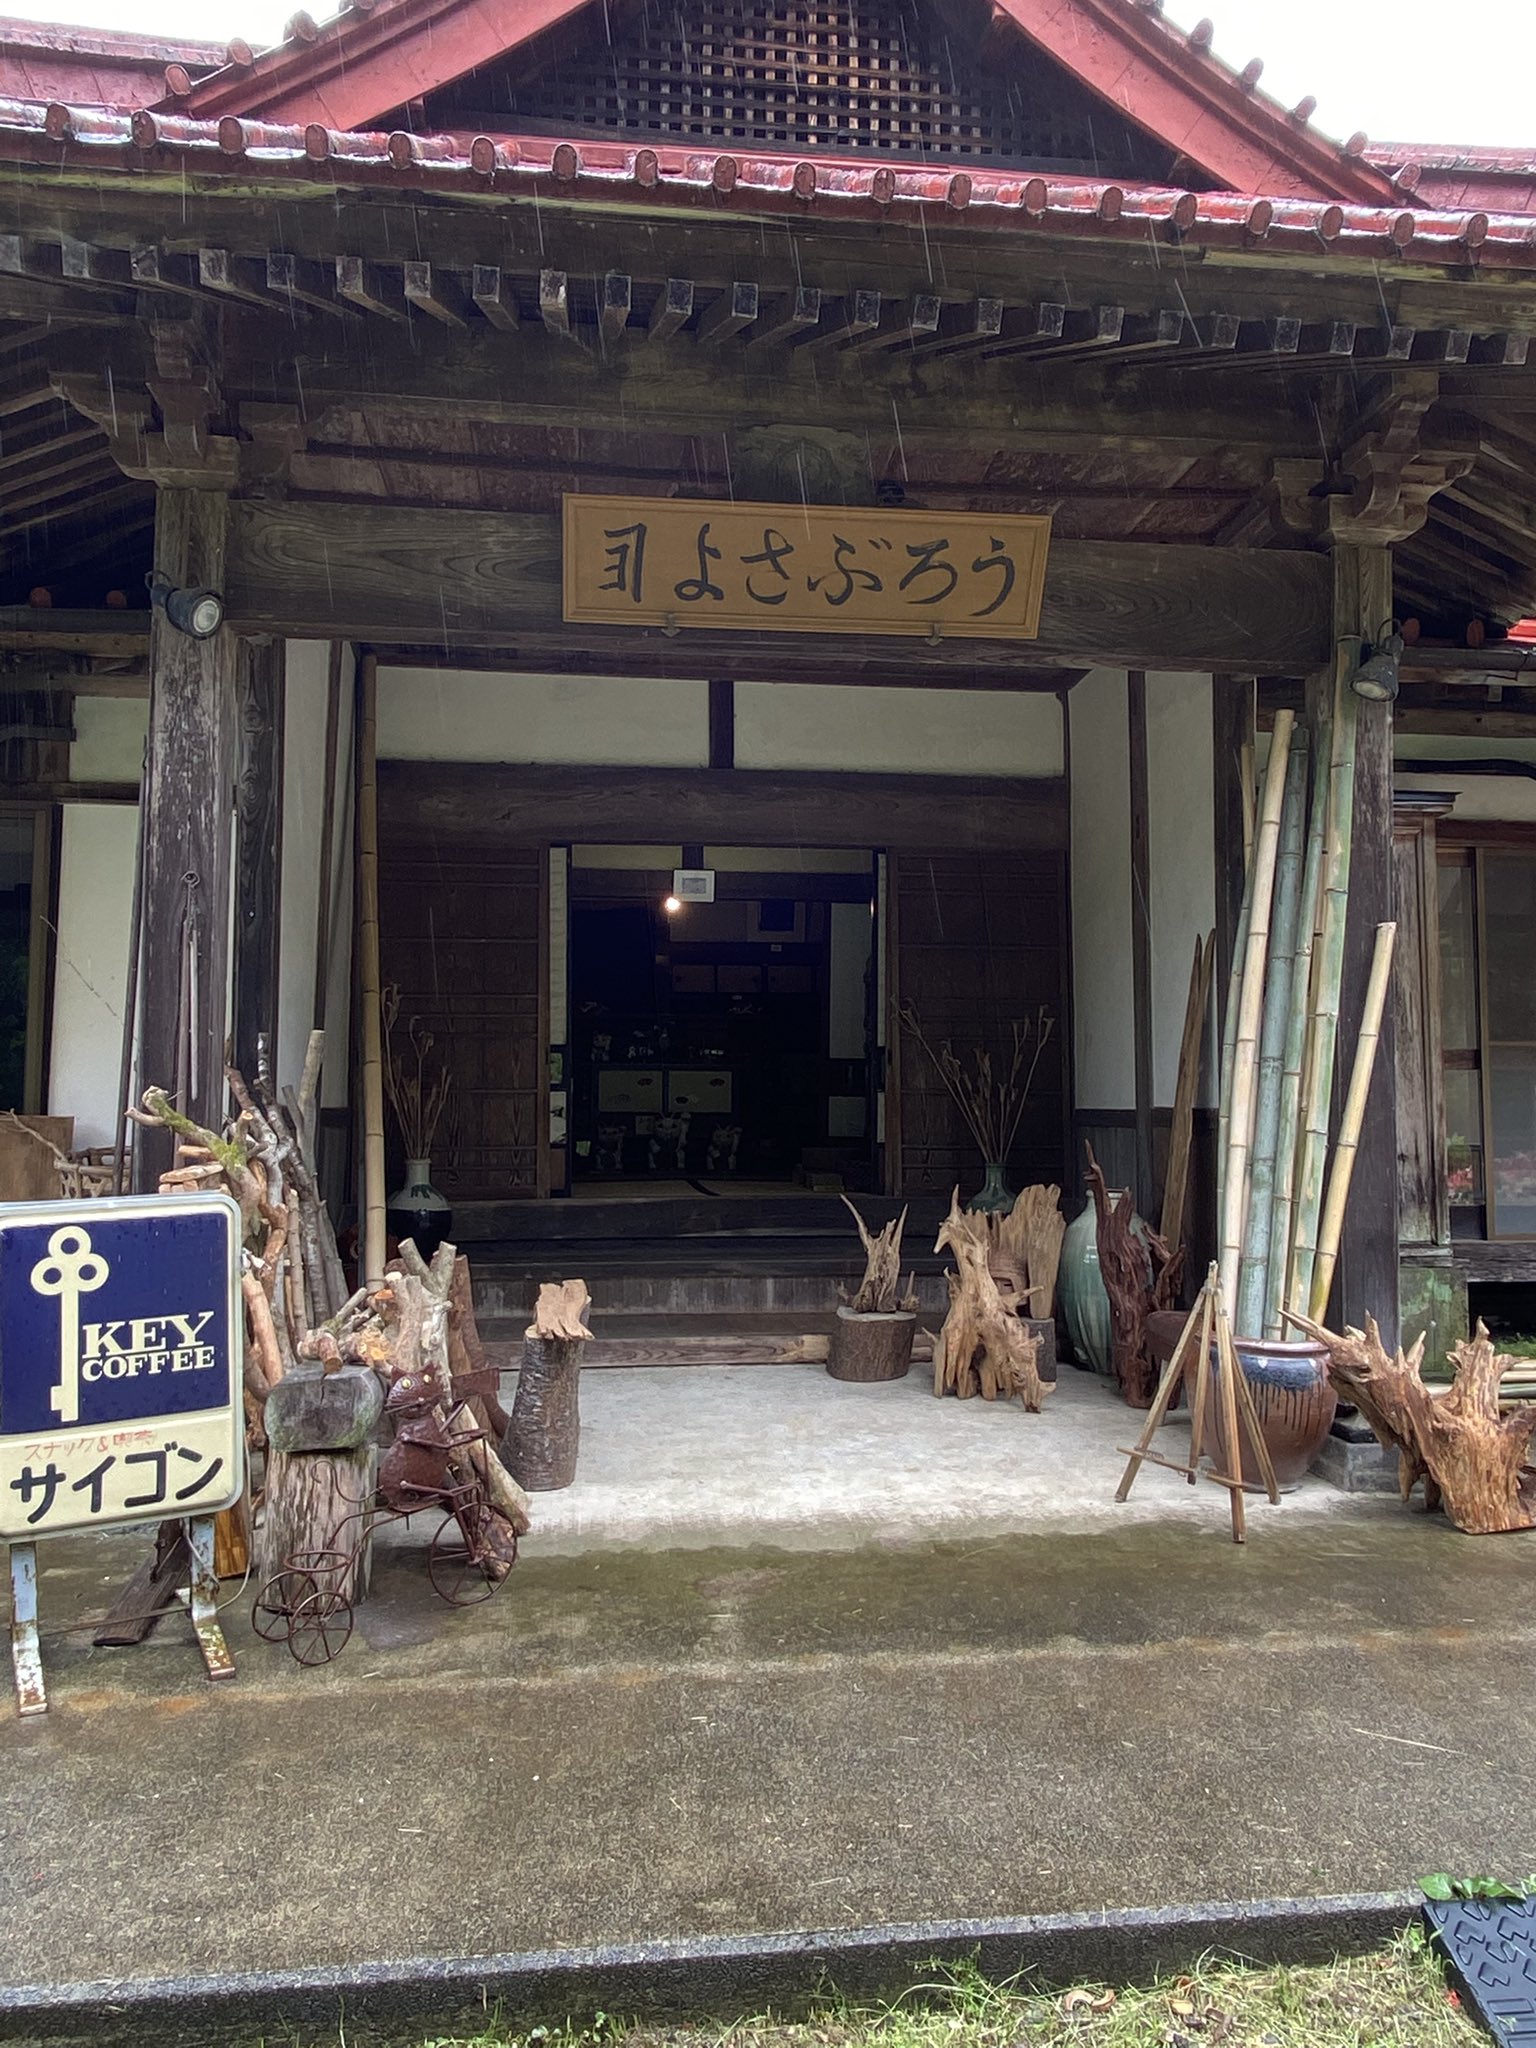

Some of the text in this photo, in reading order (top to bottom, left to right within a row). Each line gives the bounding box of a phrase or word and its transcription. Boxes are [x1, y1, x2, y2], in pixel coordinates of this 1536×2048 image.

[81, 1311, 215, 1360] KEY
[81, 1346, 215, 1382] COFFEE
[10, 1441, 224, 1524] サイゴン
